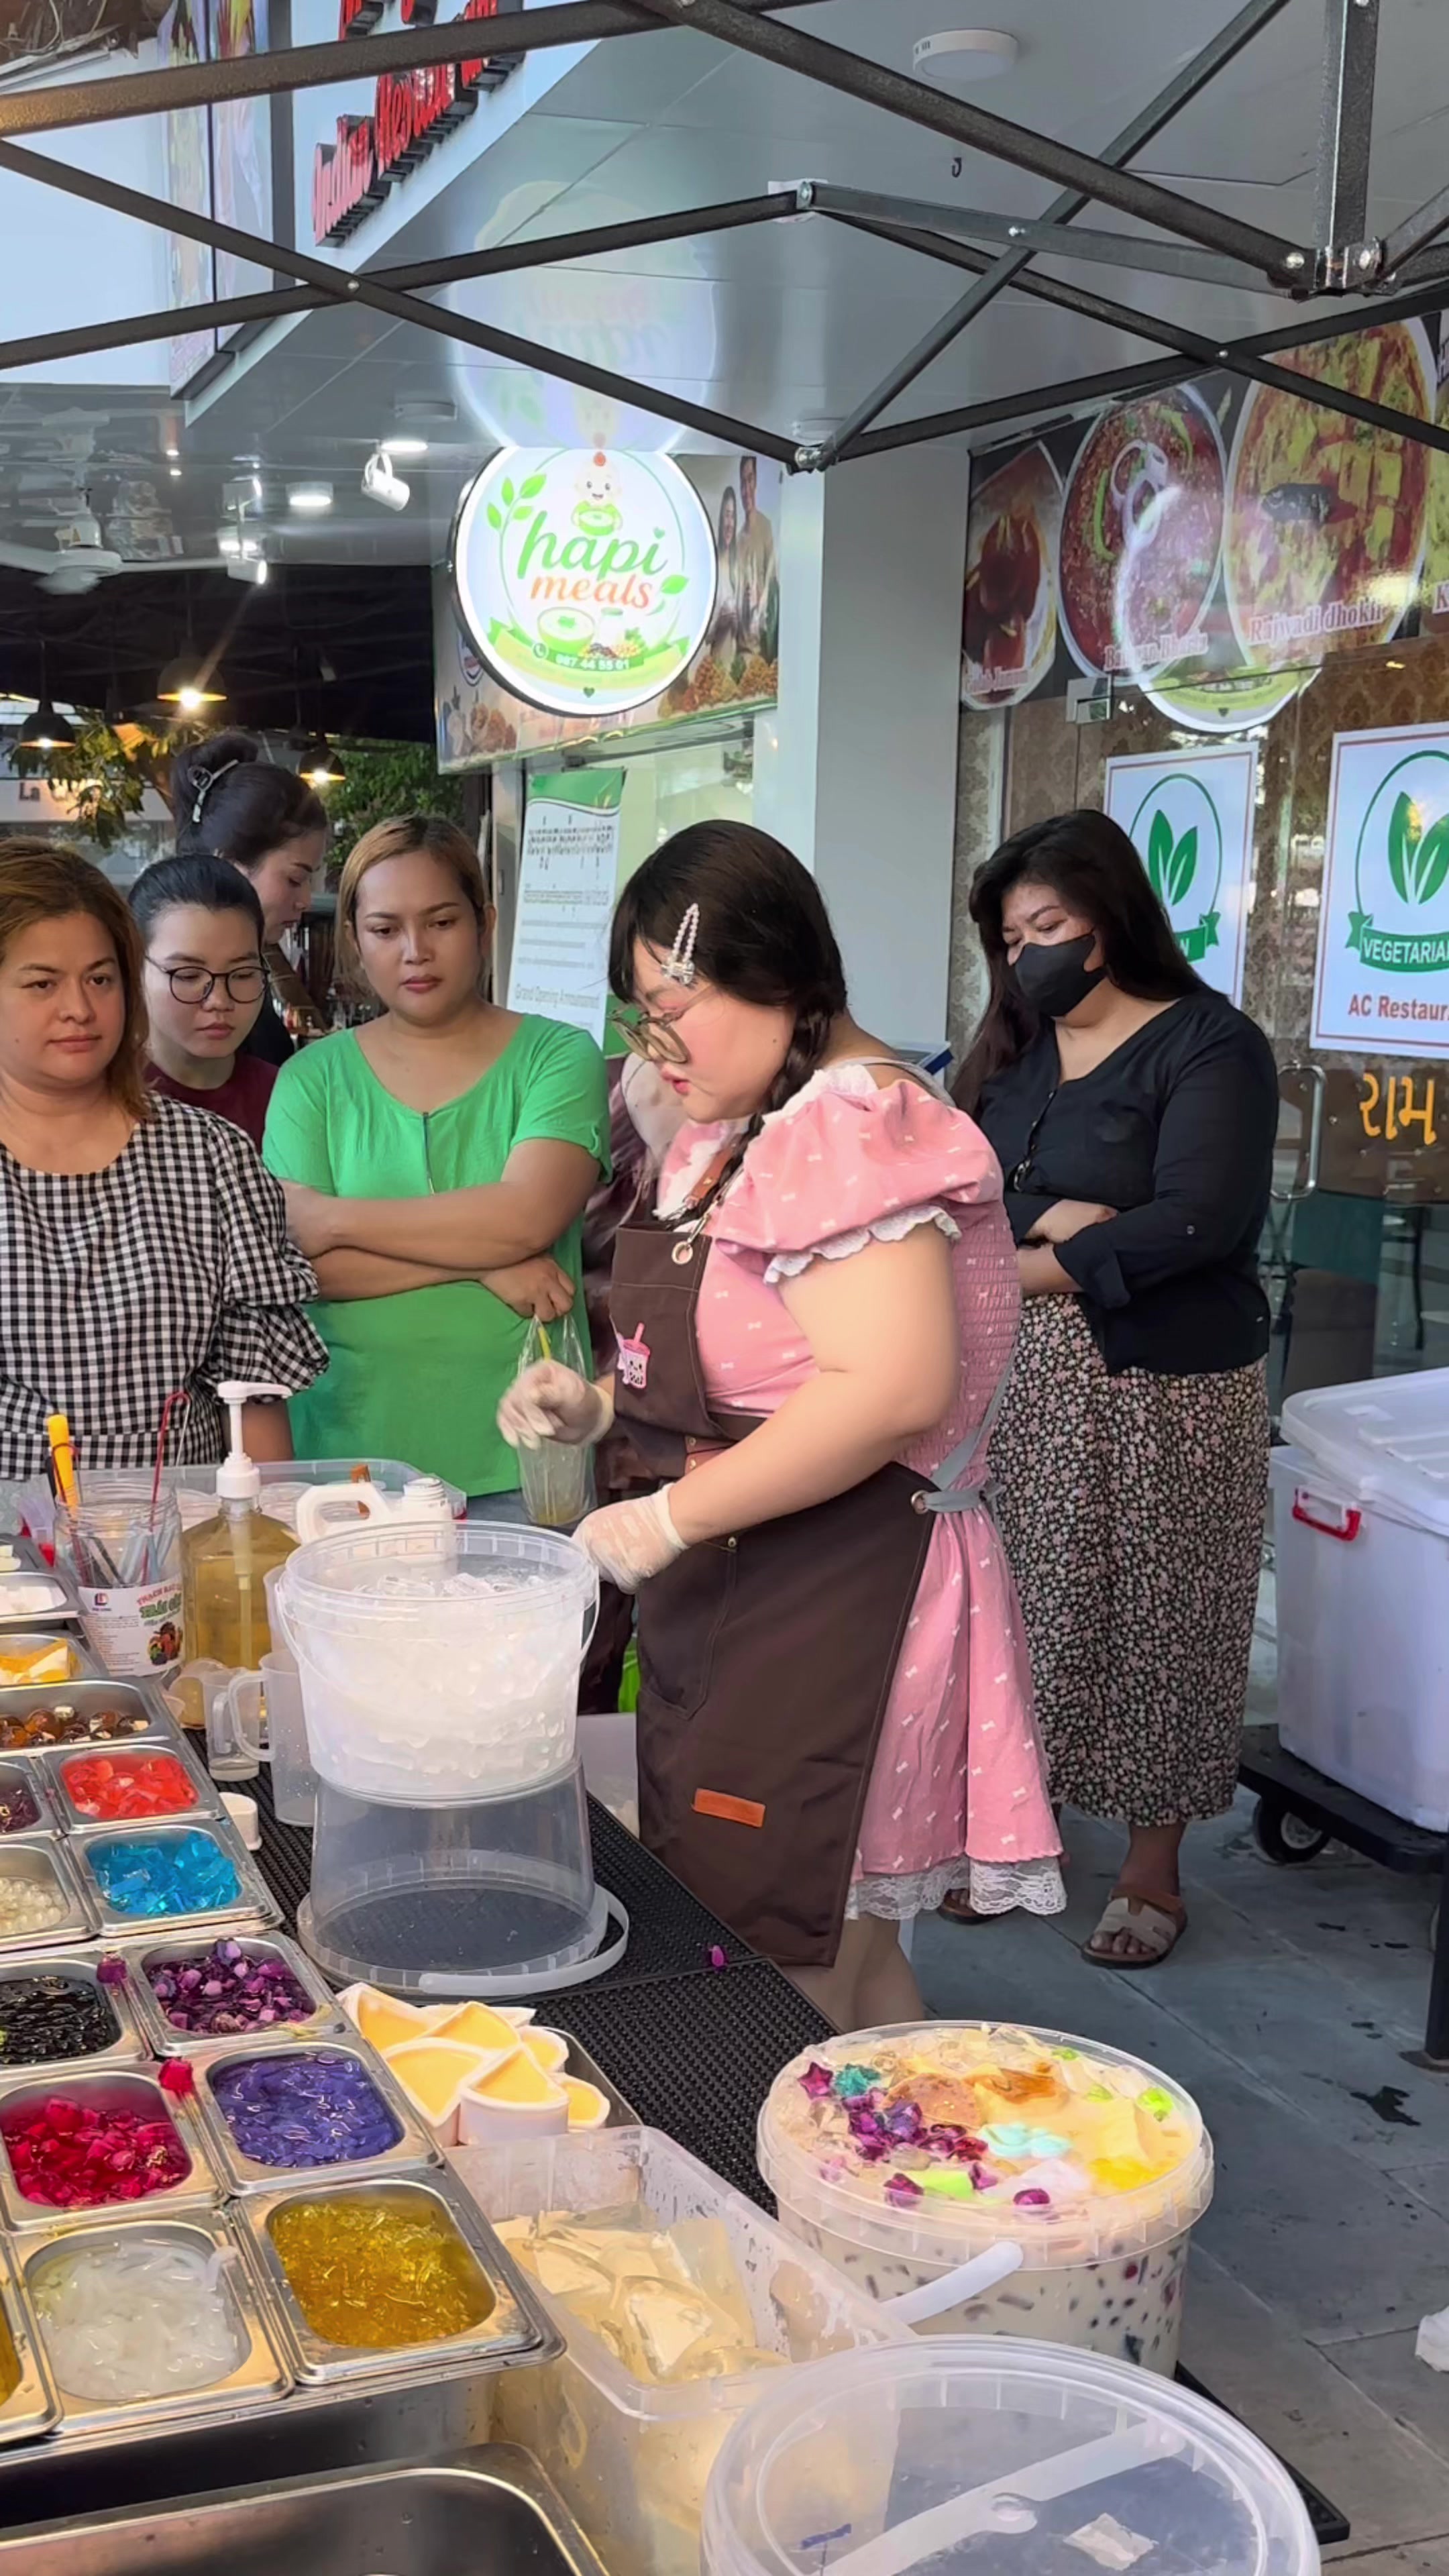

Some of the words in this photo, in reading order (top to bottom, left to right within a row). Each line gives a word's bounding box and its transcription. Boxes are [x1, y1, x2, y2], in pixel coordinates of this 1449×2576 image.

[517, 511, 668, 580] hapi
[530, 574, 652, 608] meals
[1348, 994, 1372, 1016] AC
[1378, 996, 1449, 1021] Restaur
[1360, 1073, 1437, 1145] રામ
